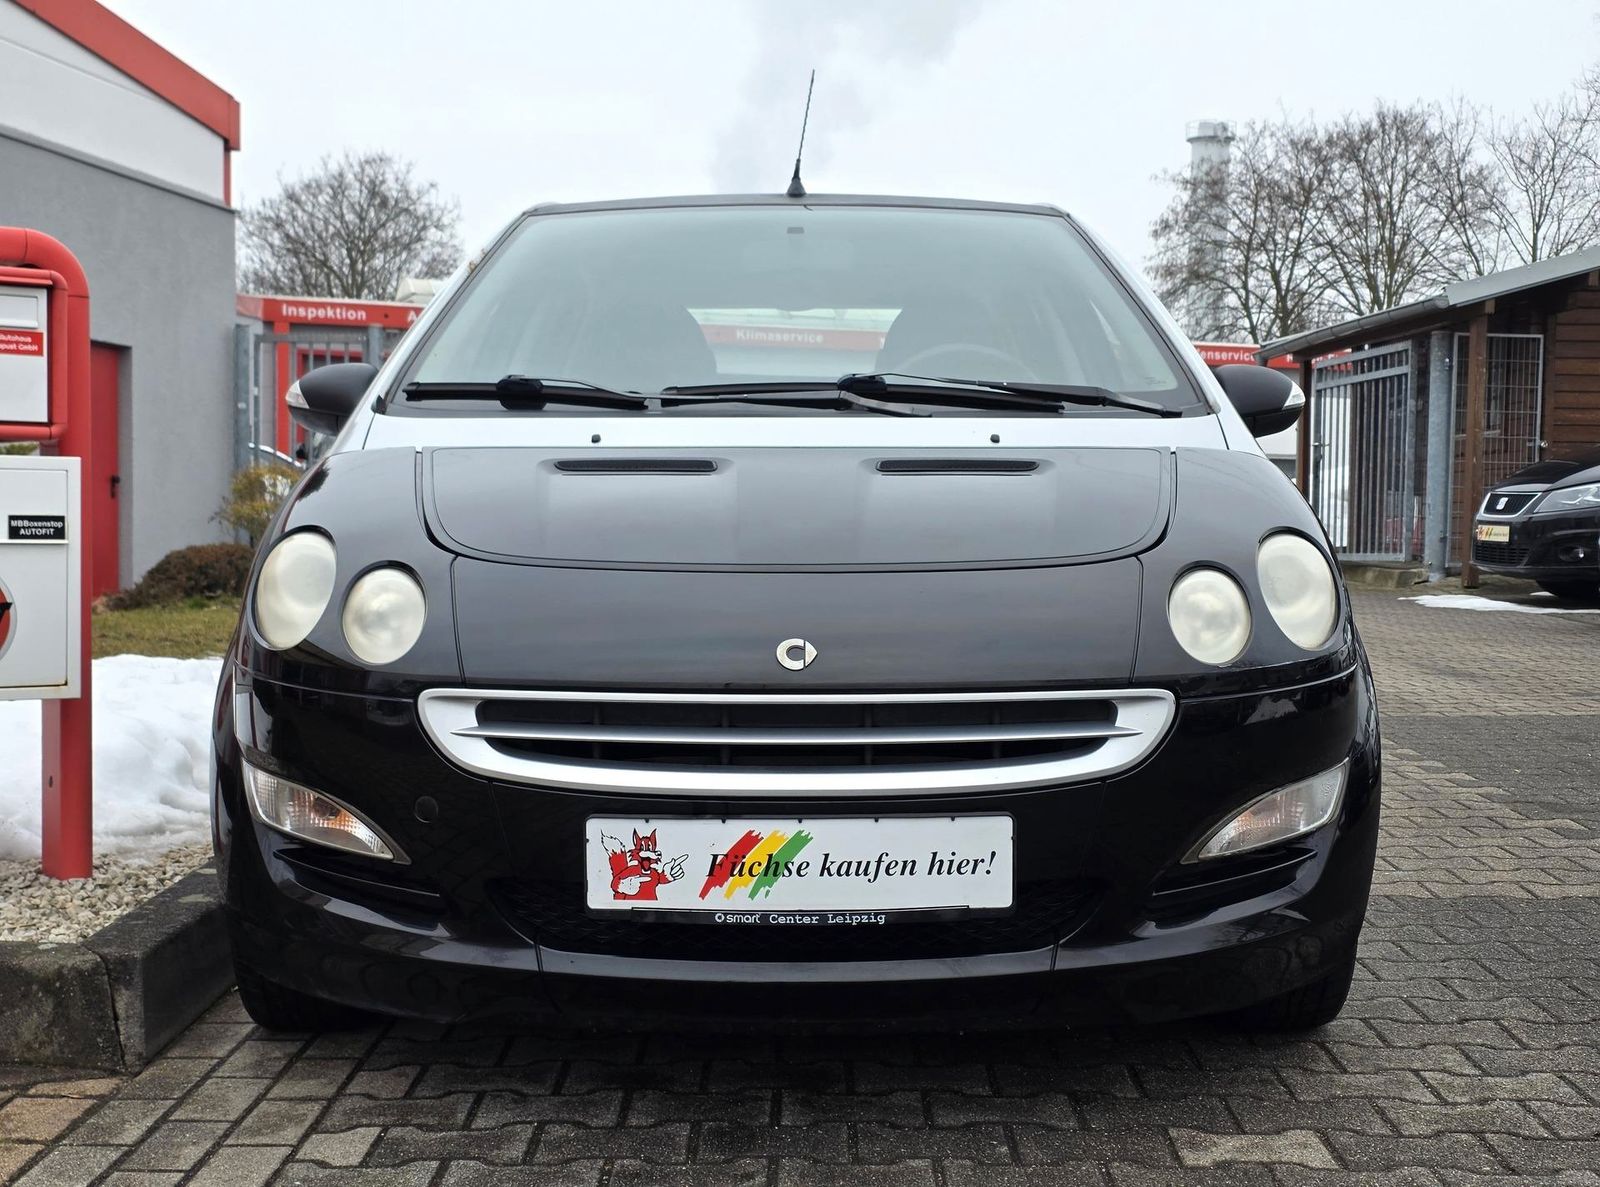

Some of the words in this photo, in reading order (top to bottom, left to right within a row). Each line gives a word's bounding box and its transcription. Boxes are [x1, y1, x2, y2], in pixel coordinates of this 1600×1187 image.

[281, 303, 366, 320] Inspektion
[736, 329, 824, 344] Klimaservice
[18, 343, 39, 352] GmbH
[19, 527, 55, 536] AUTOFIT
[705, 852, 810, 878] Füchse
[818, 851, 918, 884] kaufen
[926, 850, 998, 876] hier!
[726, 913, 761, 924] smart
[769, 913, 819, 924] Center
[827, 912, 886, 926] Leipzig
